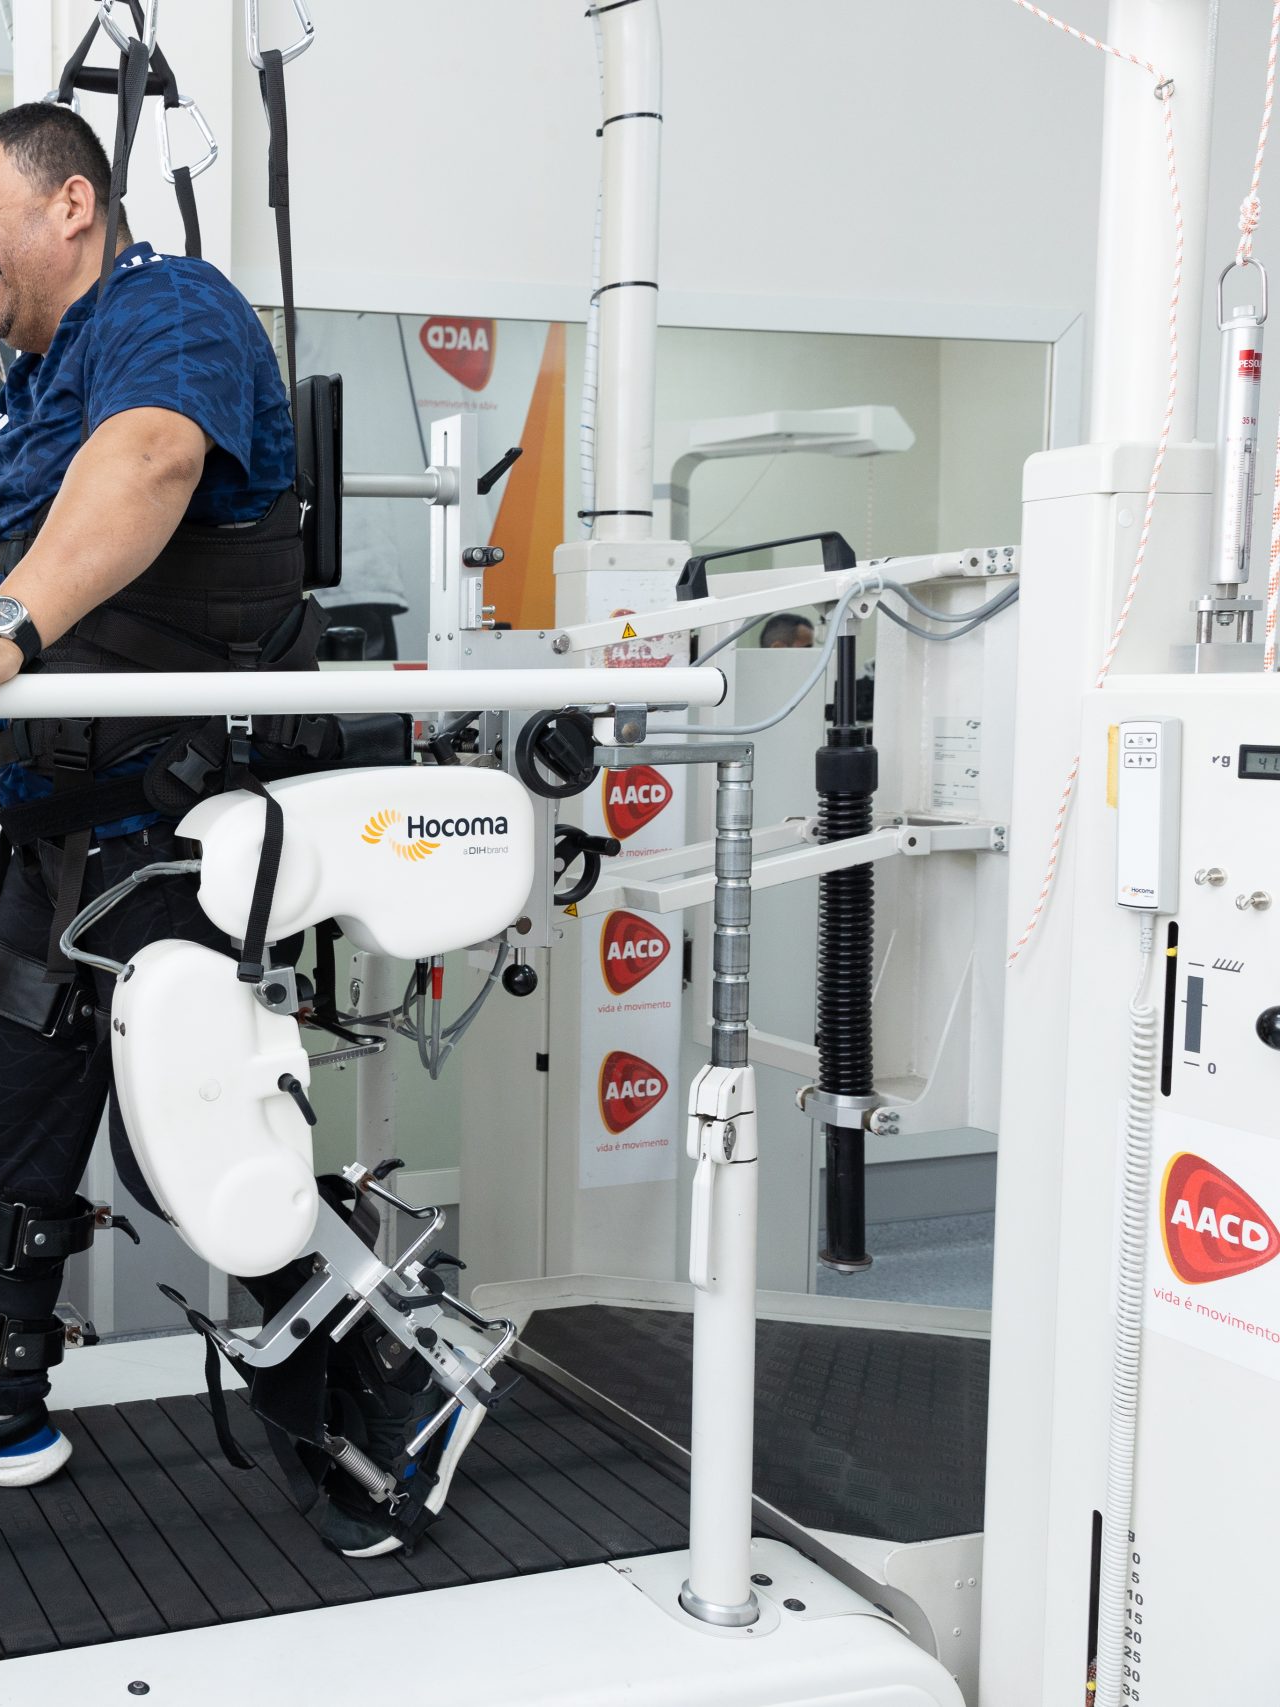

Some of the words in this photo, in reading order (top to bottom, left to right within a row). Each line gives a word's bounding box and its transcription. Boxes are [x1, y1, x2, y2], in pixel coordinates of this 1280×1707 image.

[1239, 359, 1261, 368] PESOL
[1241, 416, 1250, 425] 35
[609, 784, 667, 805] AACD
[407, 815, 508, 838] Hocoma
[469, 846, 486, 855] DIH
[487, 846, 509, 854] brand
[626, 847, 672, 857] movim
[1131, 887, 1155, 895] Hocoma
[607, 939, 664, 961] AACD
[598, 1003, 615, 1013] vida
[624, 1000, 671, 1012] movimento
[1208, 1062, 1217, 1075] 0
[605, 1078, 662, 1100] AACD
[596, 1143, 613, 1153] vida
[622, 1138, 669, 1150] movimento
[1170, 1198, 1269, 1252] AACD
[1153, 1287, 1180, 1306] vida
[1184, 1296, 1193, 1310] é
[1196, 1304, 1280, 1343] movimento
[1132, 1552, 1141, 1565] 0
[1131, 1571, 1140, 1584] 5
[1126, 1589, 1144, 1606] 10
[1125, 1608, 1143, 1625] 15
[1124, 1626, 1142, 1644] 20
[1123, 1645, 1141, 1664] 25
[1123, 1664, 1140, 1683] 30
[1122, 1683, 1140, 1702] 35
